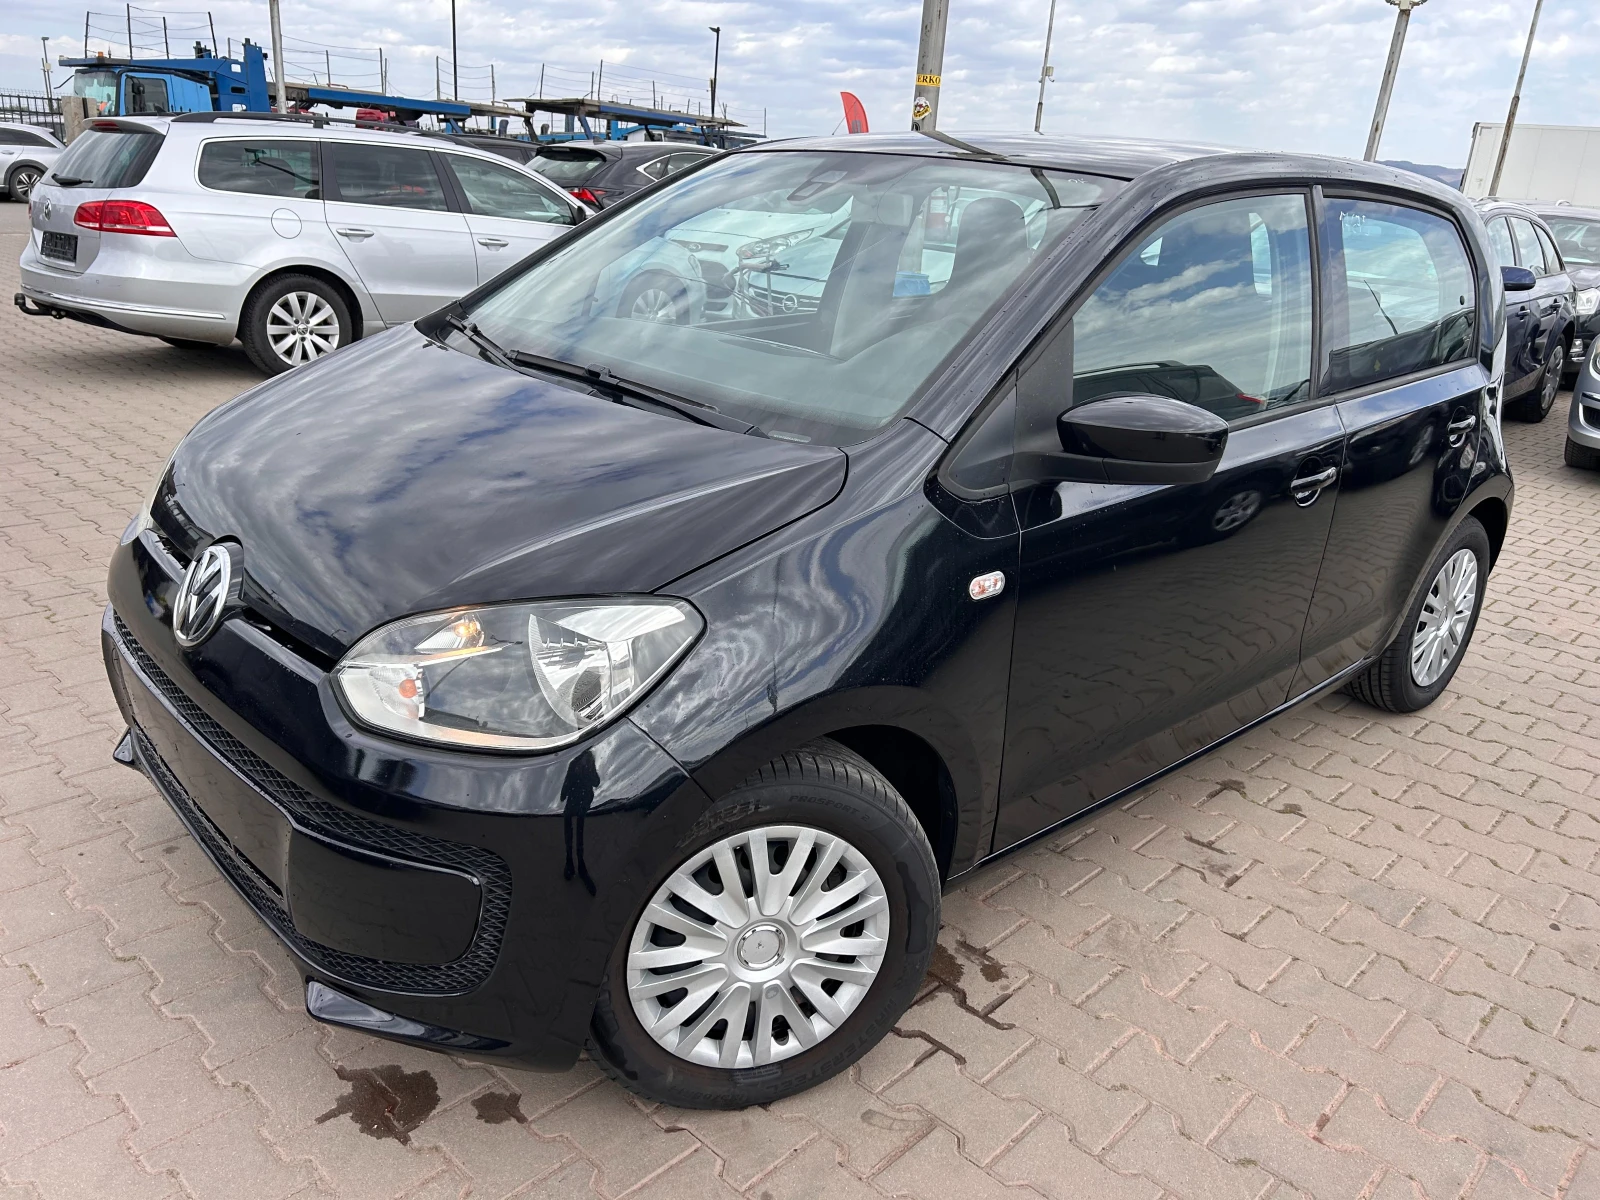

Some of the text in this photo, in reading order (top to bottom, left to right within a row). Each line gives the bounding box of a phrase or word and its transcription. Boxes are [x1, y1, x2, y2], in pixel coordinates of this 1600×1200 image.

[788, 794, 871, 823] PROSPORT 2
[765, 998, 898, 1095] MASTERSTEEL
